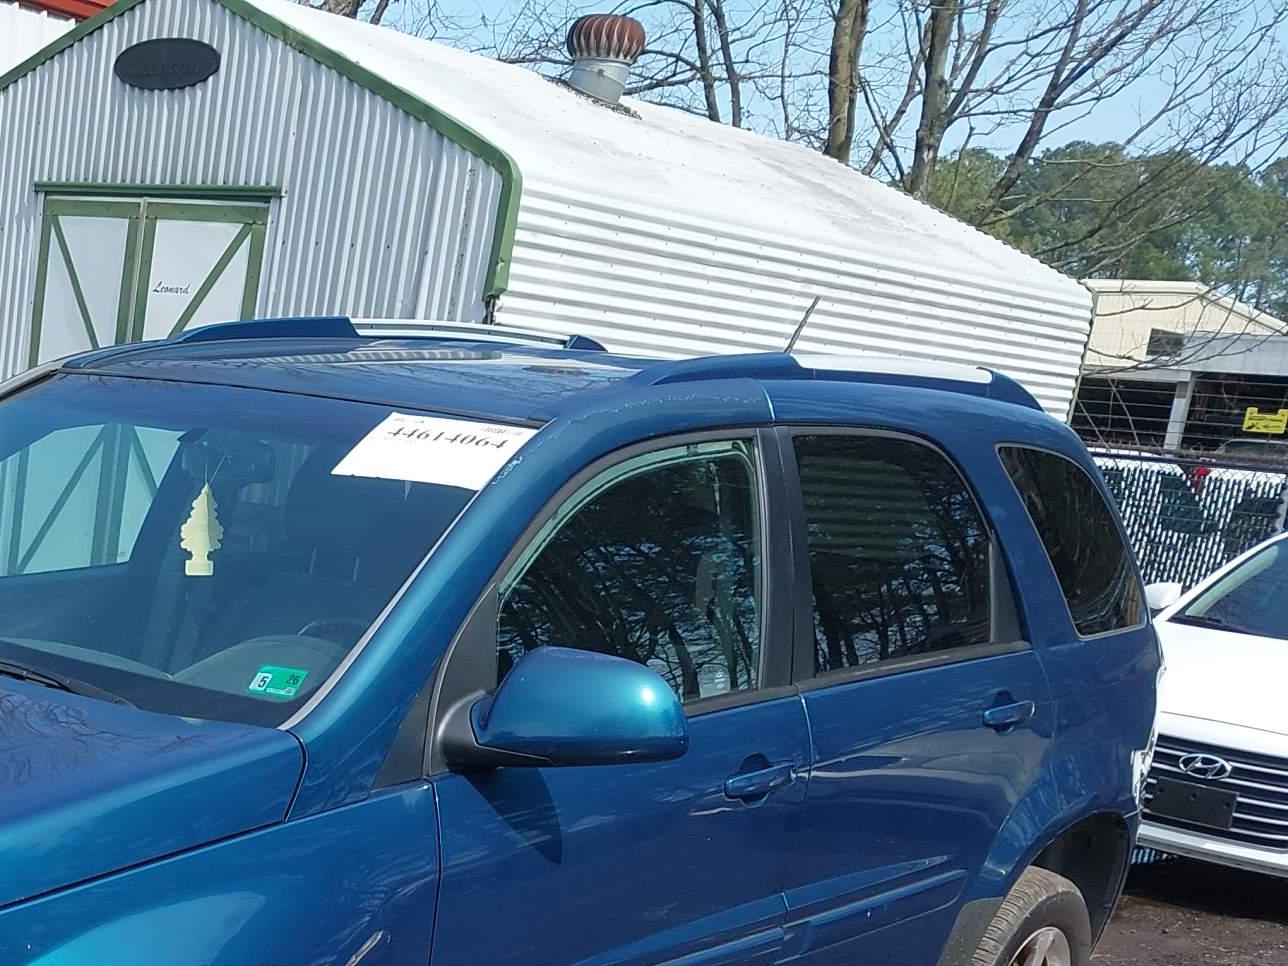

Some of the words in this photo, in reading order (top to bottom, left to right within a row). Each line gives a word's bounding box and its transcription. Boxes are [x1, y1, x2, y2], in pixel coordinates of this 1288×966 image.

[152, 281, 191, 294] Leonard
[388, 426, 508, 449] 44614064
[257, 676, 269, 688] 5
[285, 674, 302, 686] 26
